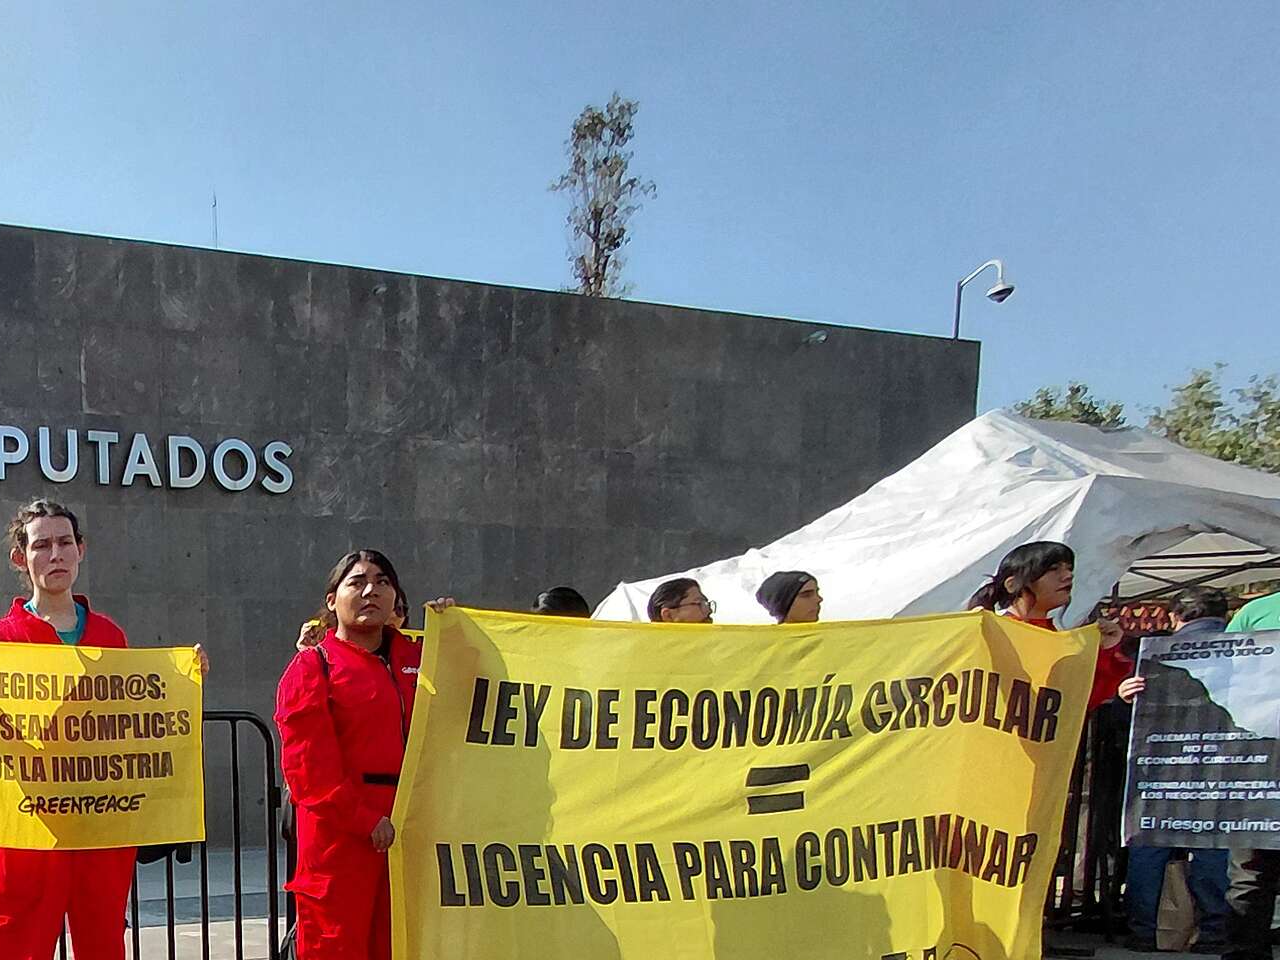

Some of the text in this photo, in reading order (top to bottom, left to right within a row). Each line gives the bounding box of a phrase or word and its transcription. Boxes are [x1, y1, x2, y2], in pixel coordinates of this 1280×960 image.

[465, 668, 1063, 751] LEY DE ECONOMÍA CIRCULAR
[0, 713, 59, 742] SEAN
[64, 709, 191, 742] CÓMPLICES
[20, 755, 48, 782] LA
[52, 751, 174, 782] INDUSTRIA
[17, 793, 146, 815] GREENPEACE
[1247, 790, 1265, 800] LA
[1140, 816, 1157, 830] El
[1160, 816, 1216, 834] riesgo
[435, 813, 1039, 908] LICENCIA PARA CONTAMINAR
